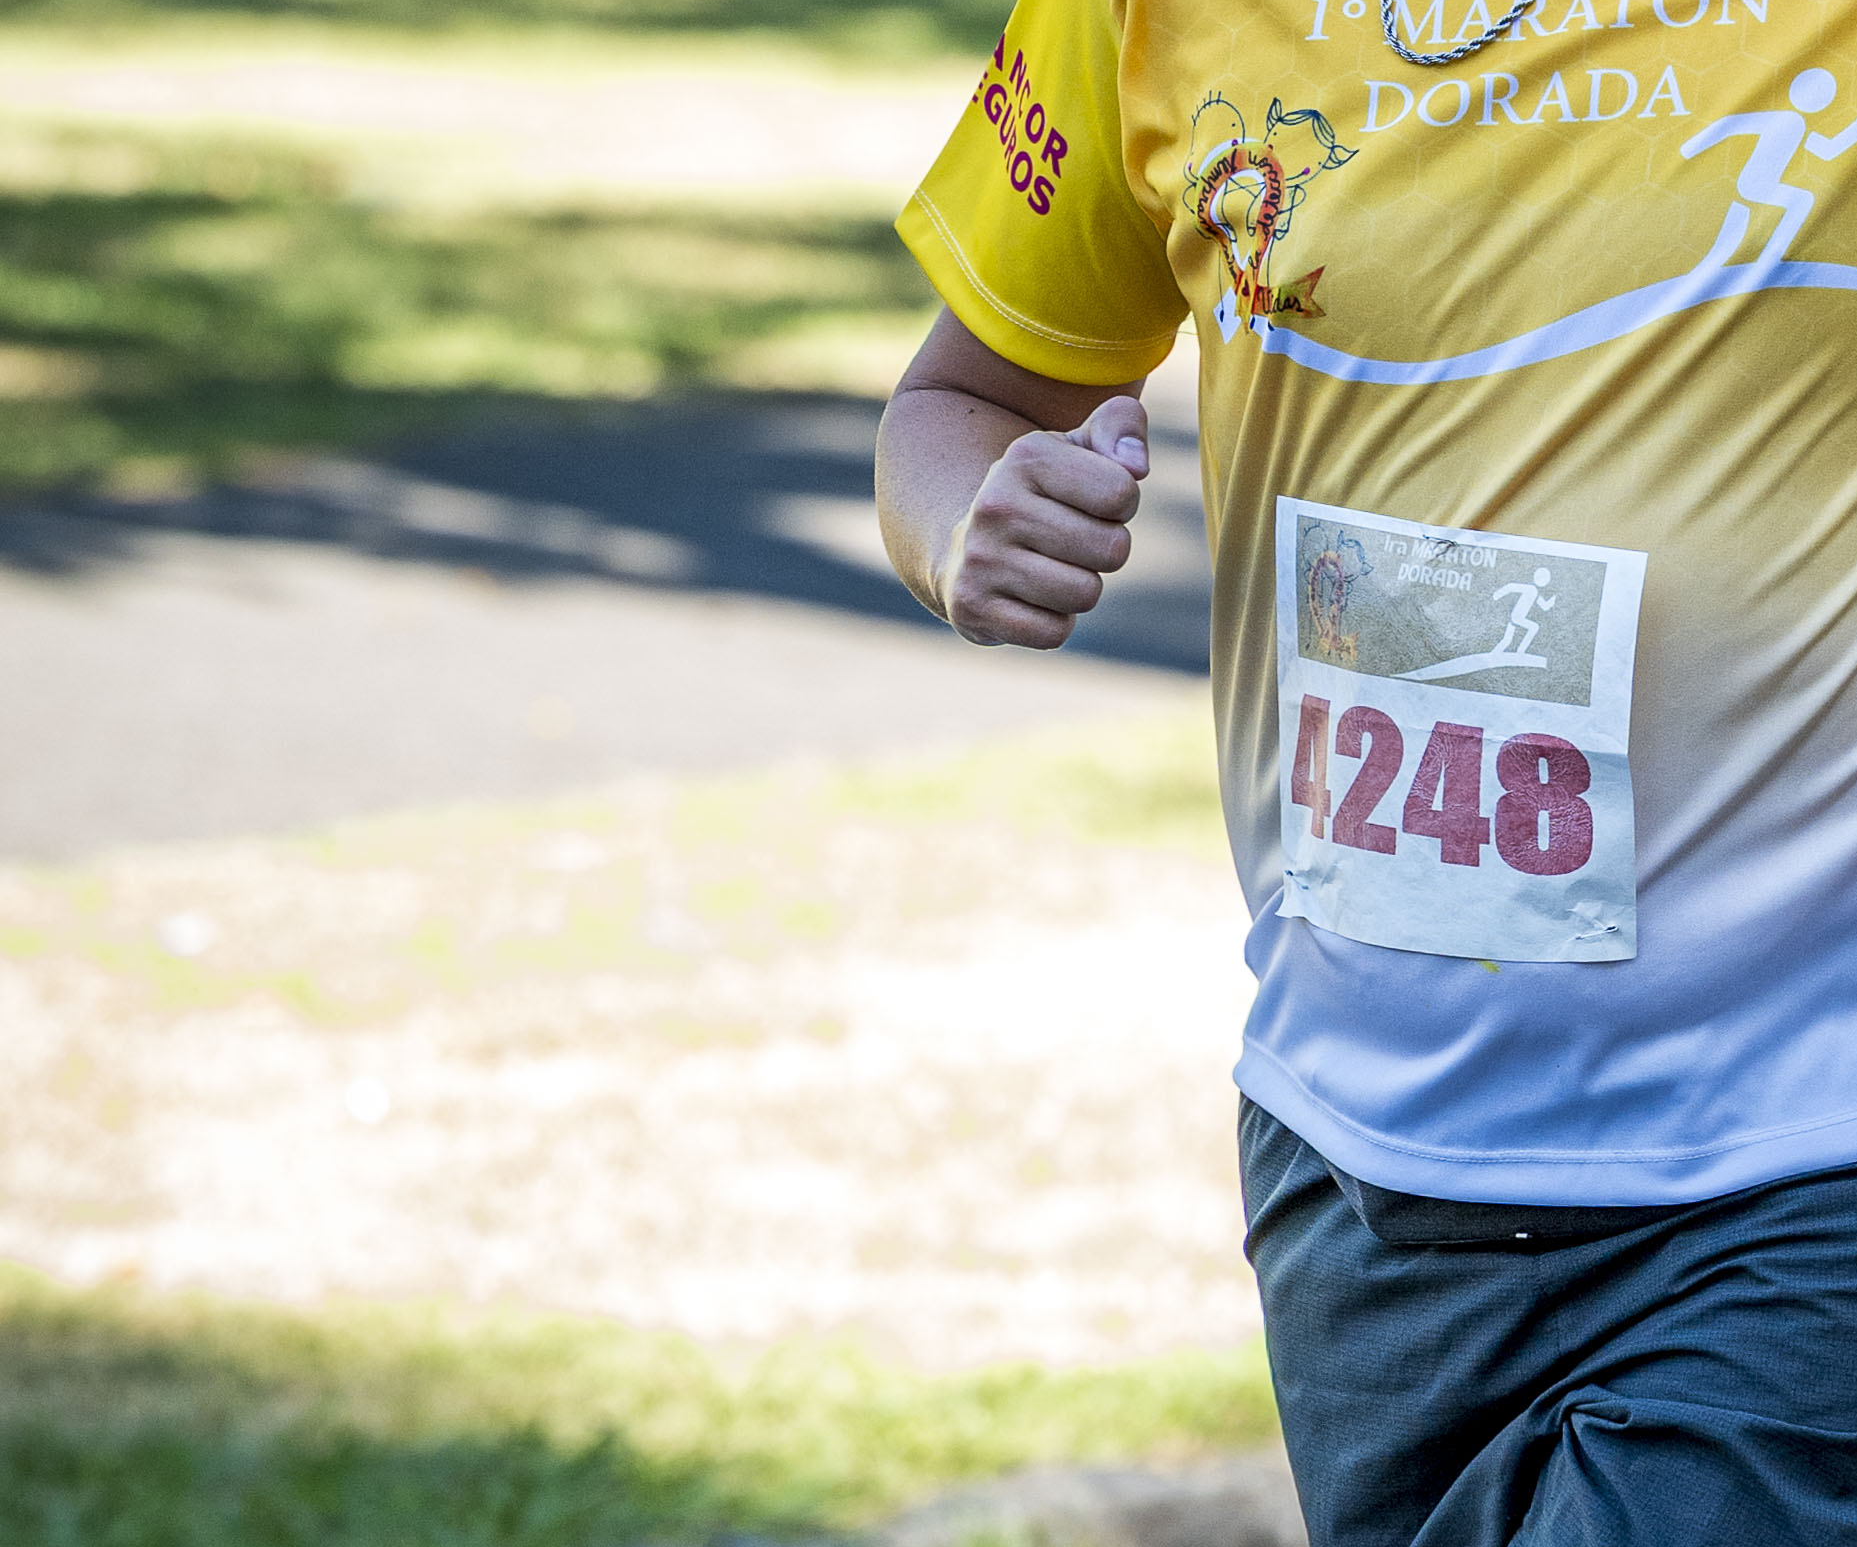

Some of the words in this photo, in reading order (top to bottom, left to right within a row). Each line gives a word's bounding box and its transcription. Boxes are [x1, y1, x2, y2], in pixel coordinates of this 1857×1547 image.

[972, 71, 1056, 216] GUROS
[1358, 65, 1691, 133] DORADA
[1397, 563, 1472, 591] DORADA
[1291, 694, 1592, 875] 4248
